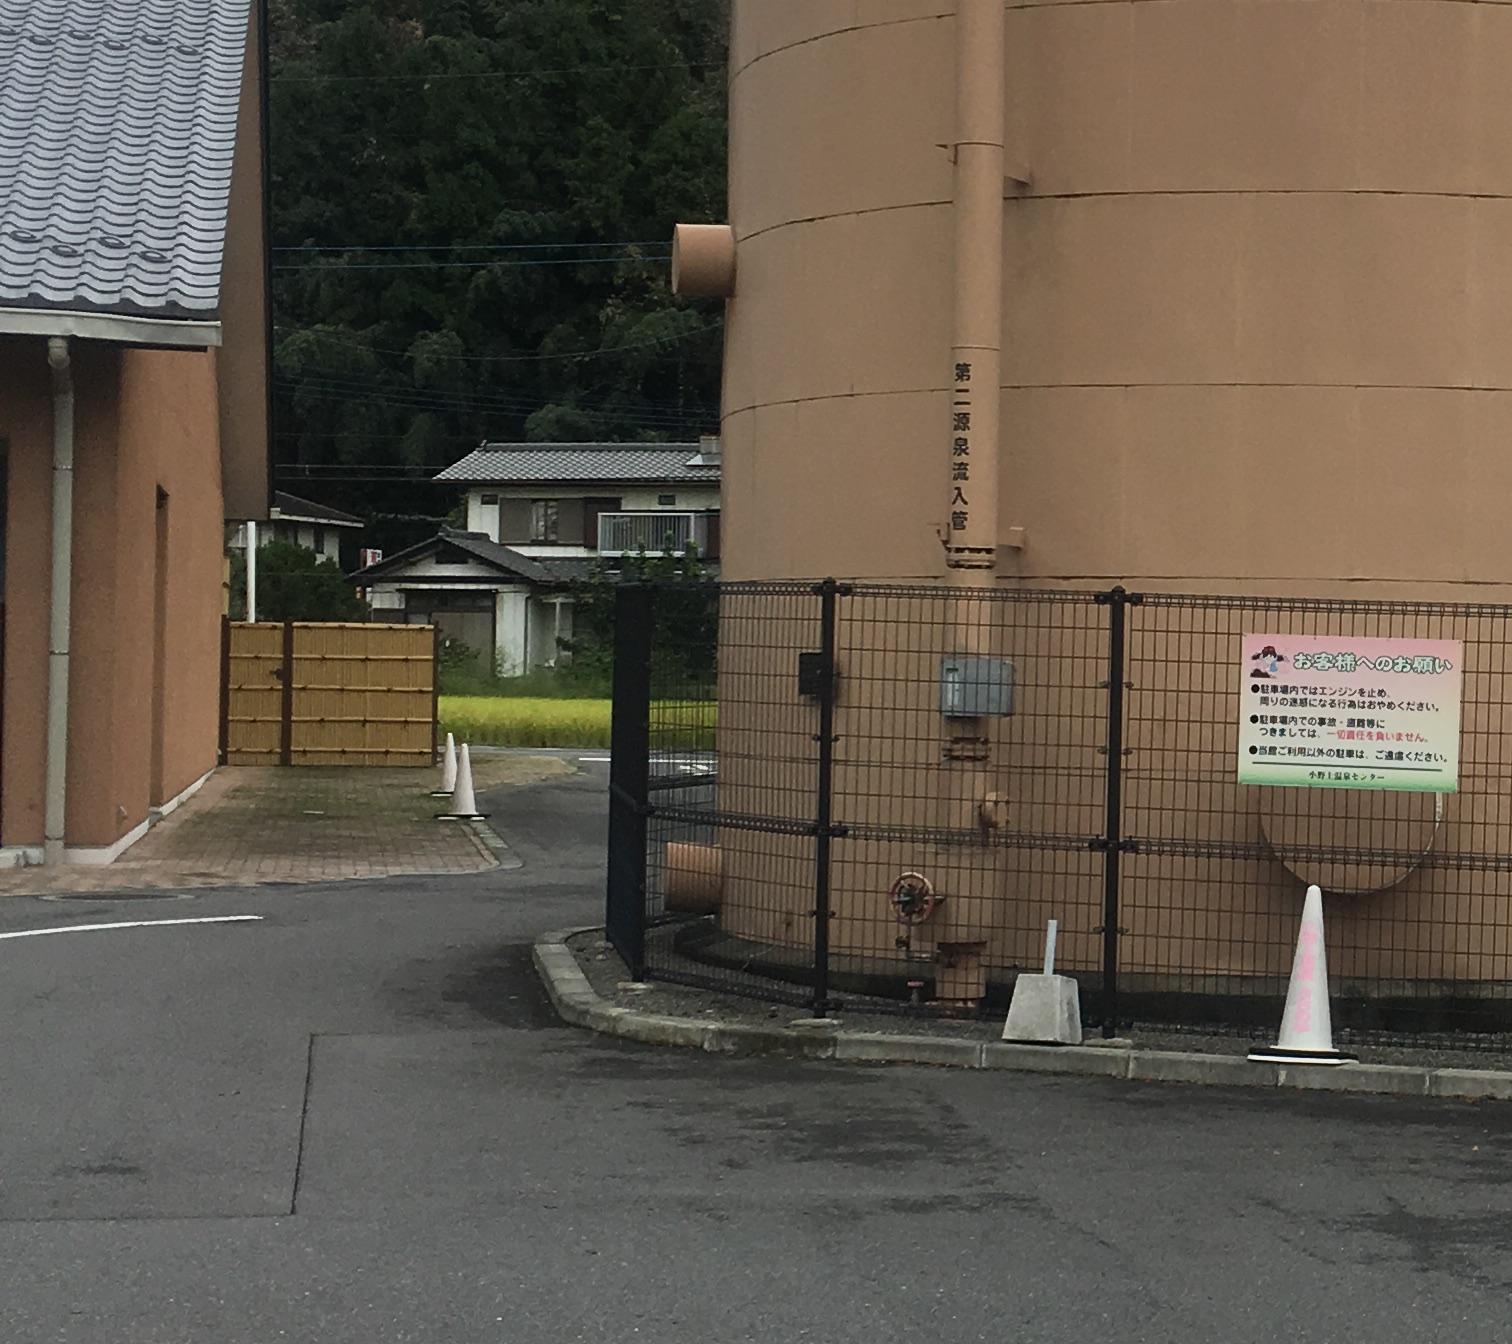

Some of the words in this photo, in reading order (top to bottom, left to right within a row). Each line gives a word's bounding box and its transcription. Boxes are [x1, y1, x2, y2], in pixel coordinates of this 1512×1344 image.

[951, 362, 972, 531] 第二源泉流入管
[1292, 651, 1453, 675] お客様へのお願い
